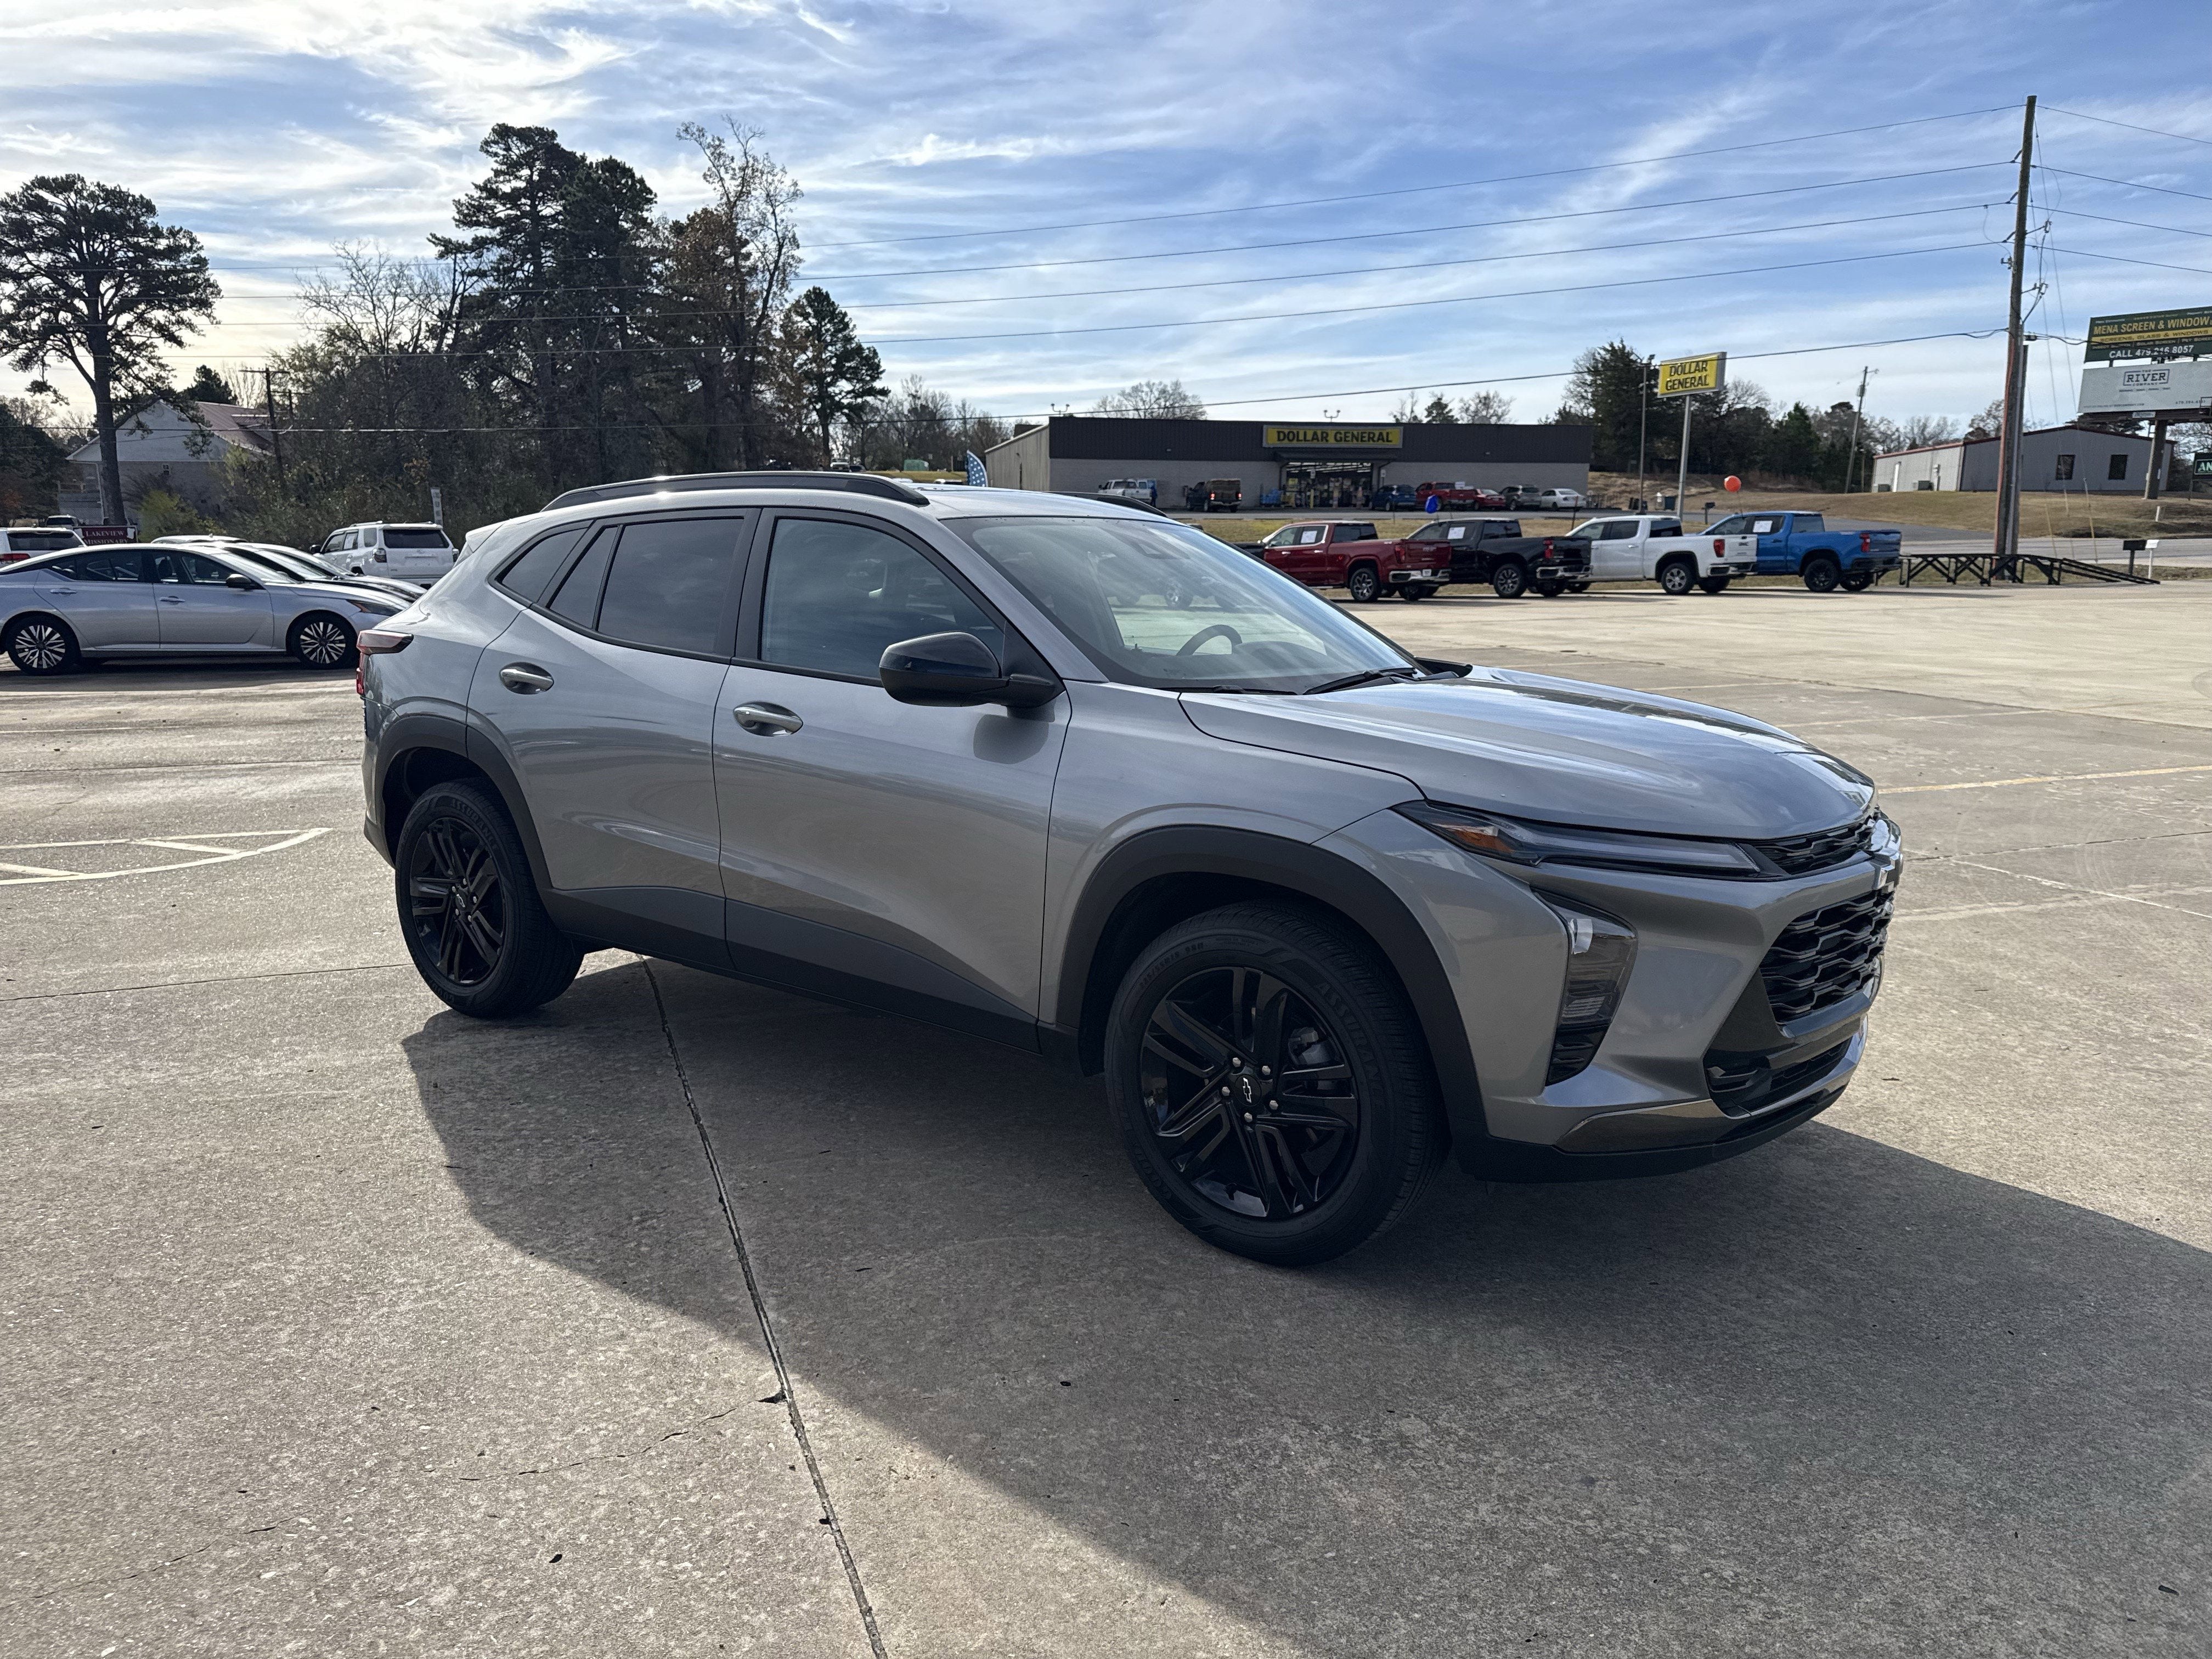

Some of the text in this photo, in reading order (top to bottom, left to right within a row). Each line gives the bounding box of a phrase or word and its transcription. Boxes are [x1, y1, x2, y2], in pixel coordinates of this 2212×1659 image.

[2094, 325, 2118, 335] MENA
[2121, 321, 2156, 332] SCREEN
[2158, 320, 2165, 329] &
[2168, 316, 2210, 328] WINDOW
[2109, 349, 2133, 358] CALL
[2135, 345, 2194, 356] 479.2168057
[1669, 360, 1708, 377] DOLLAR
[1666, 374, 1709, 391] GENERAL
[2126, 373, 2166, 382] RIVER
[1277, 430, 1393, 443] DOLLAR GENERAL
[1313, 979, 1384, 1109] ASSURANCE
